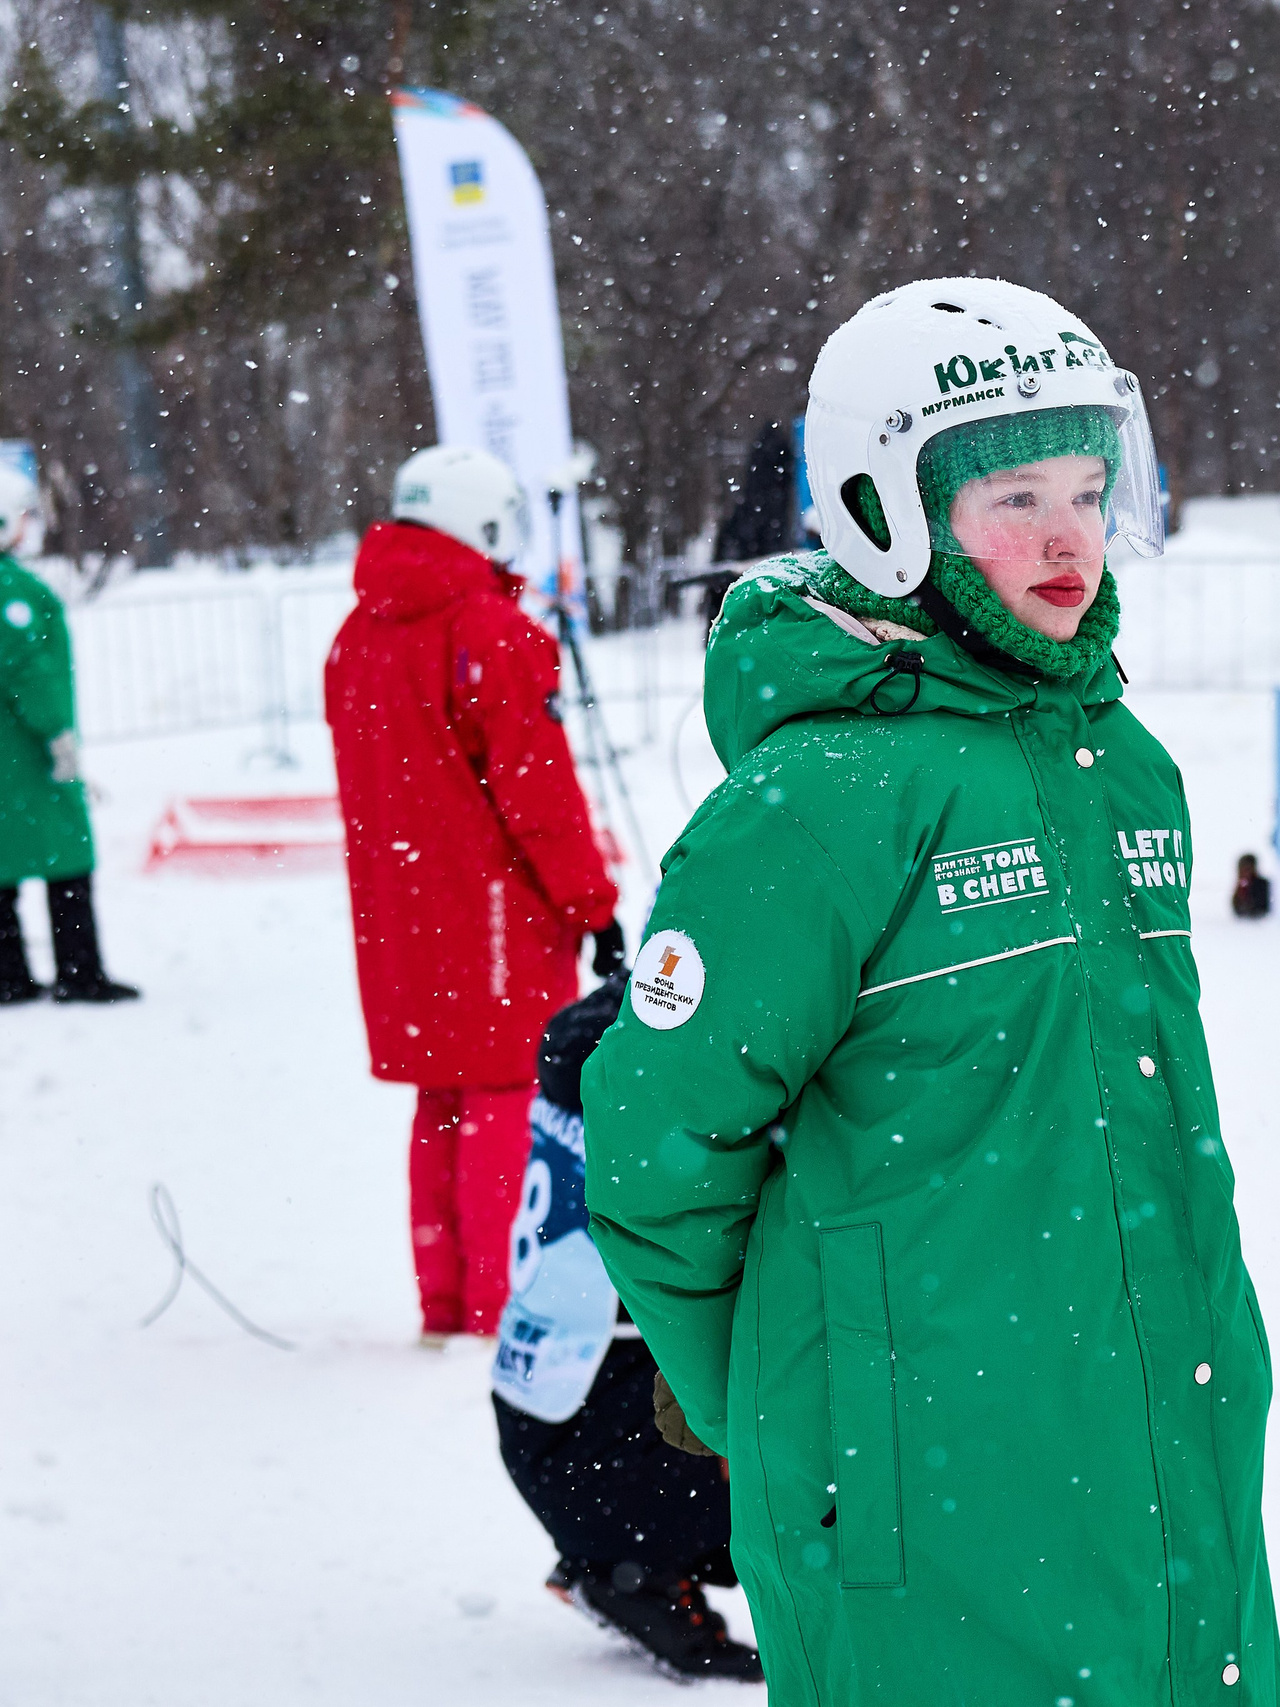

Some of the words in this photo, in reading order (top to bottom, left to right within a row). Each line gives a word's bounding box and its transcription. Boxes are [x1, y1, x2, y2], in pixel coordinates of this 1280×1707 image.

[921, 387, 1005, 417] МУРМАНСК
[1117, 829, 1169, 859] LET
[934, 860, 956, 873] ДЛЯ
[957, 856, 980, 868] ТЕХ,
[982, 845, 1041, 871] ТОЛК
[935, 870, 953, 881] КТО
[954, 866, 980, 878] ЗНАЕТ
[937, 884, 957, 906] В
[963, 866, 1047, 900] СНЕГЕ
[1127, 861, 1187, 888] SNO
[635, 981, 694, 1005] ПРЕЗИДЕНТСКИХ
[654, 977, 675, 990] ФОНД
[645, 994, 677, 1011] ГРАНТОВ
